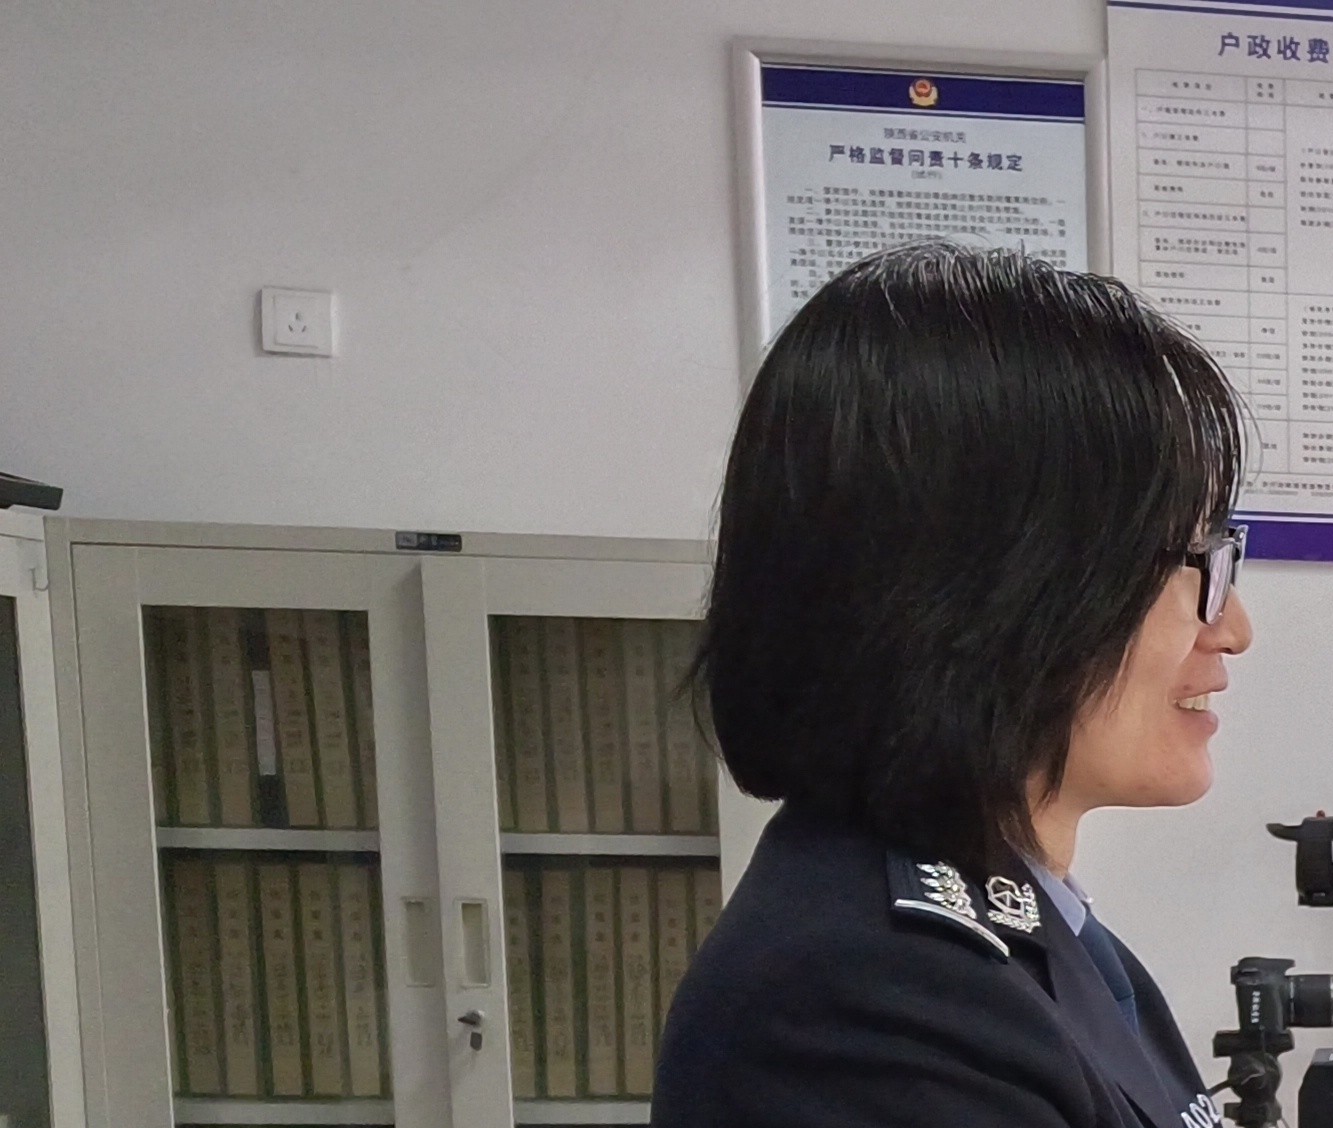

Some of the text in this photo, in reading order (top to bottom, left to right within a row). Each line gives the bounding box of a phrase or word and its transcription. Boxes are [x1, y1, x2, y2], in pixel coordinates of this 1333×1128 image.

[828, 144, 1023, 172] 严格监督问责十条规定
